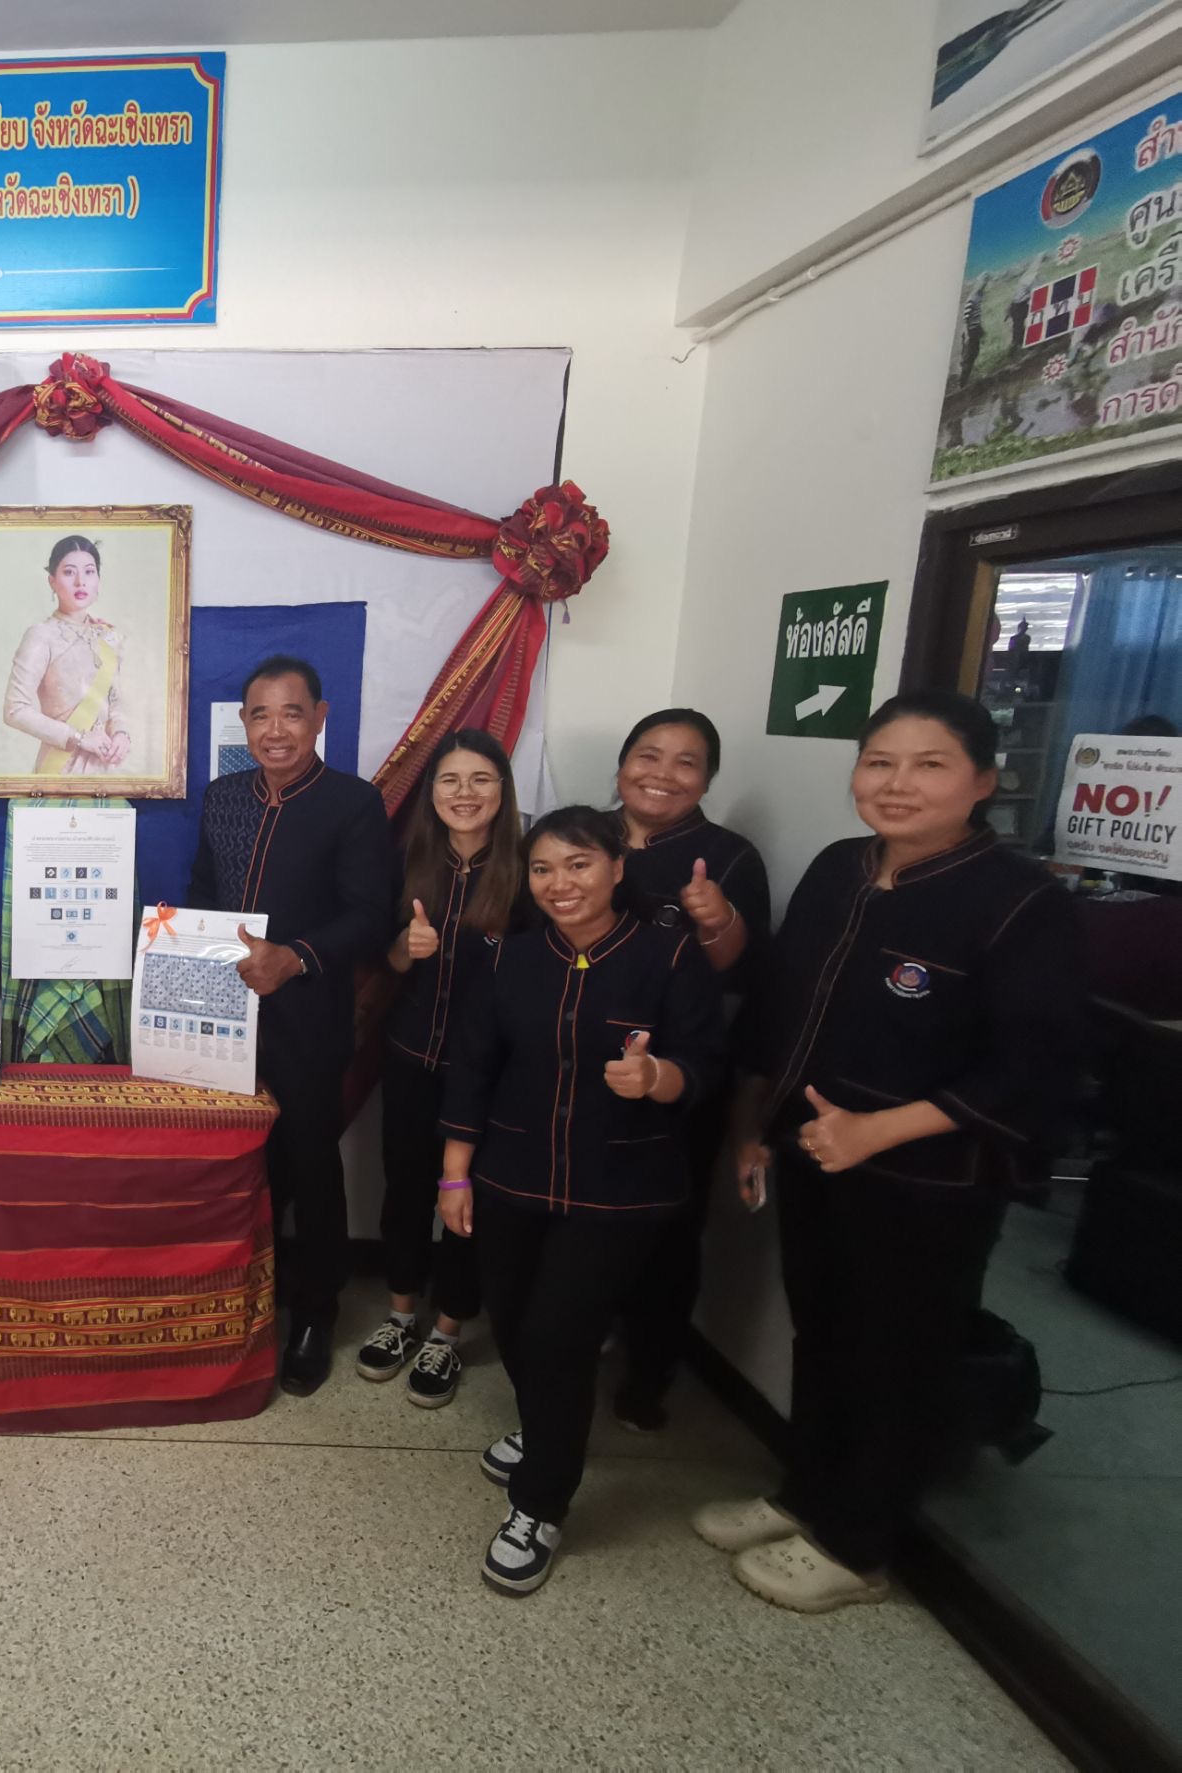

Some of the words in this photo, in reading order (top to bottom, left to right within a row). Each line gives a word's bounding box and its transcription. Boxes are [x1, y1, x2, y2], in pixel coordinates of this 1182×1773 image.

[31, 100, 192, 150] จังหวัดฉะเชิงเทรา
[785, 596, 872, 659] ห้องสัสดี
[1067, 815, 1106, 837] GIFT
[1110, 819, 1177, 845] POLICY
